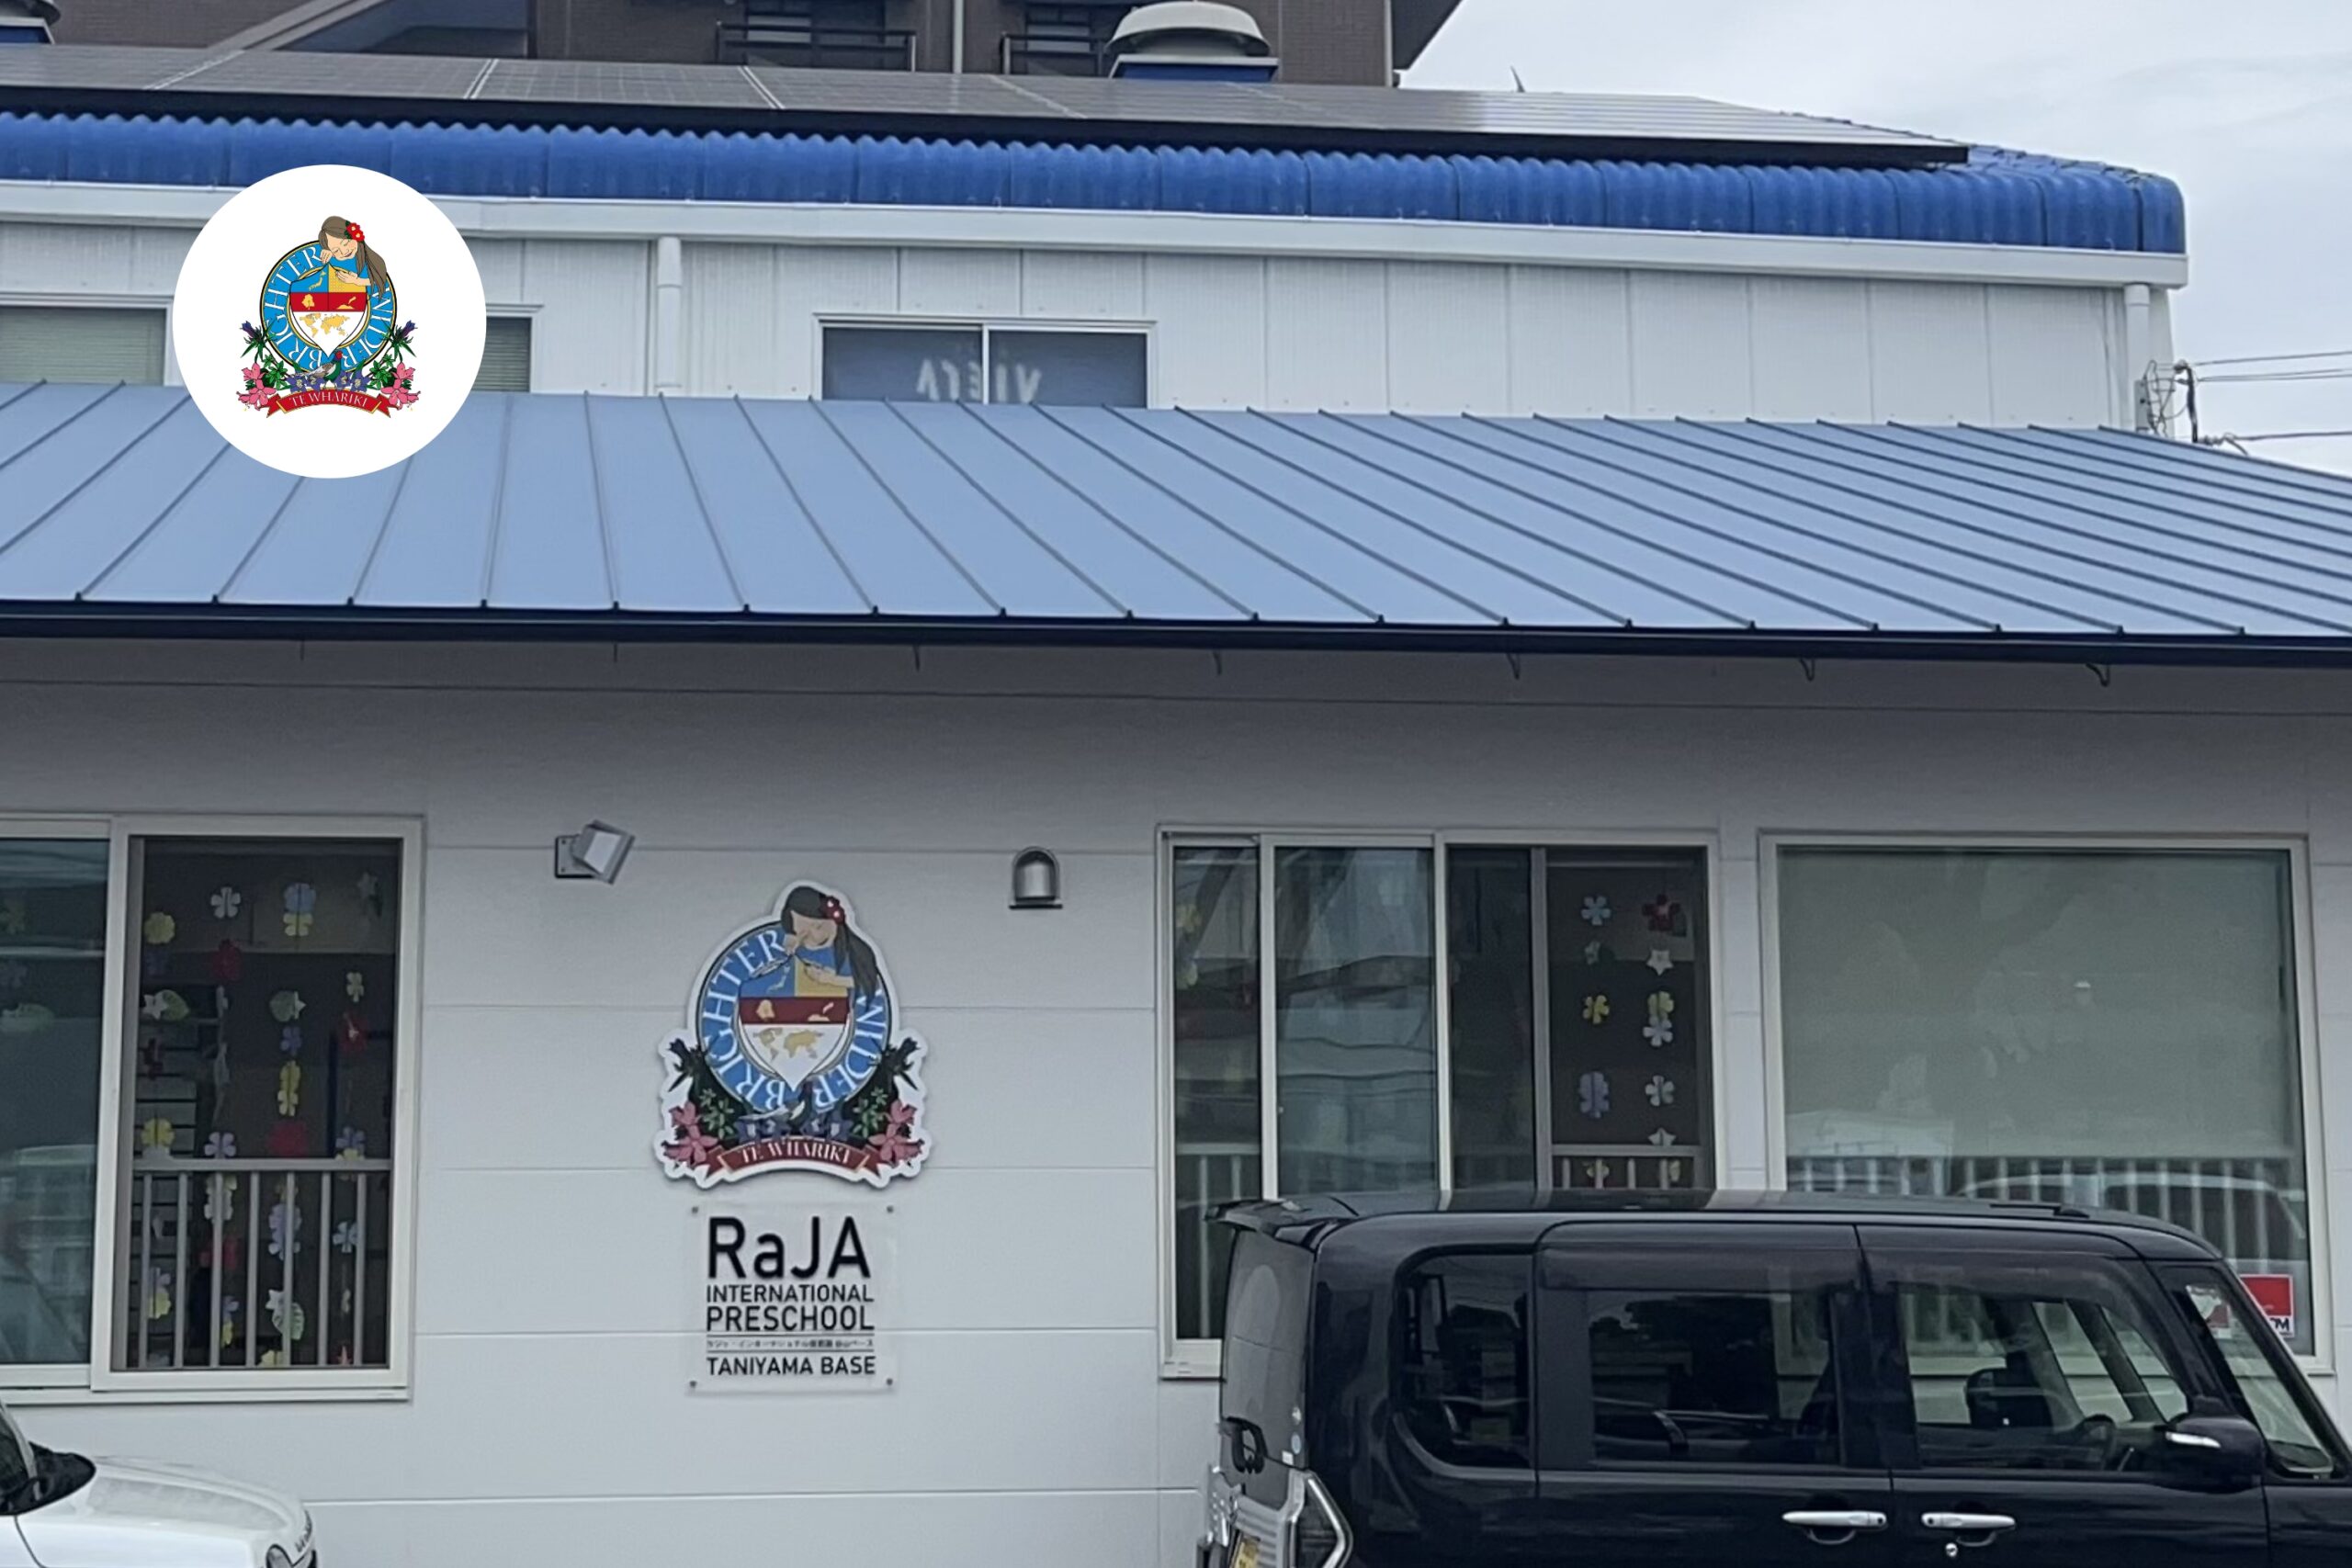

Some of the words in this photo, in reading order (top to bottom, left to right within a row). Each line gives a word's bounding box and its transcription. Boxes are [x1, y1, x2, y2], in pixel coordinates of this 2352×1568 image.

[703, 928, 786, 1111] BRIGHTER
[737, 1145, 764, 1164] TE
[708, 1216, 871, 1279] RaJA
[707, 1284, 875, 1303] INTERNATIONAL
[707, 1305, 875, 1331] PRESCHOOL
[707, 1357, 813, 1375] TANIYAMA
[820, 1356, 876, 1375] BASE
